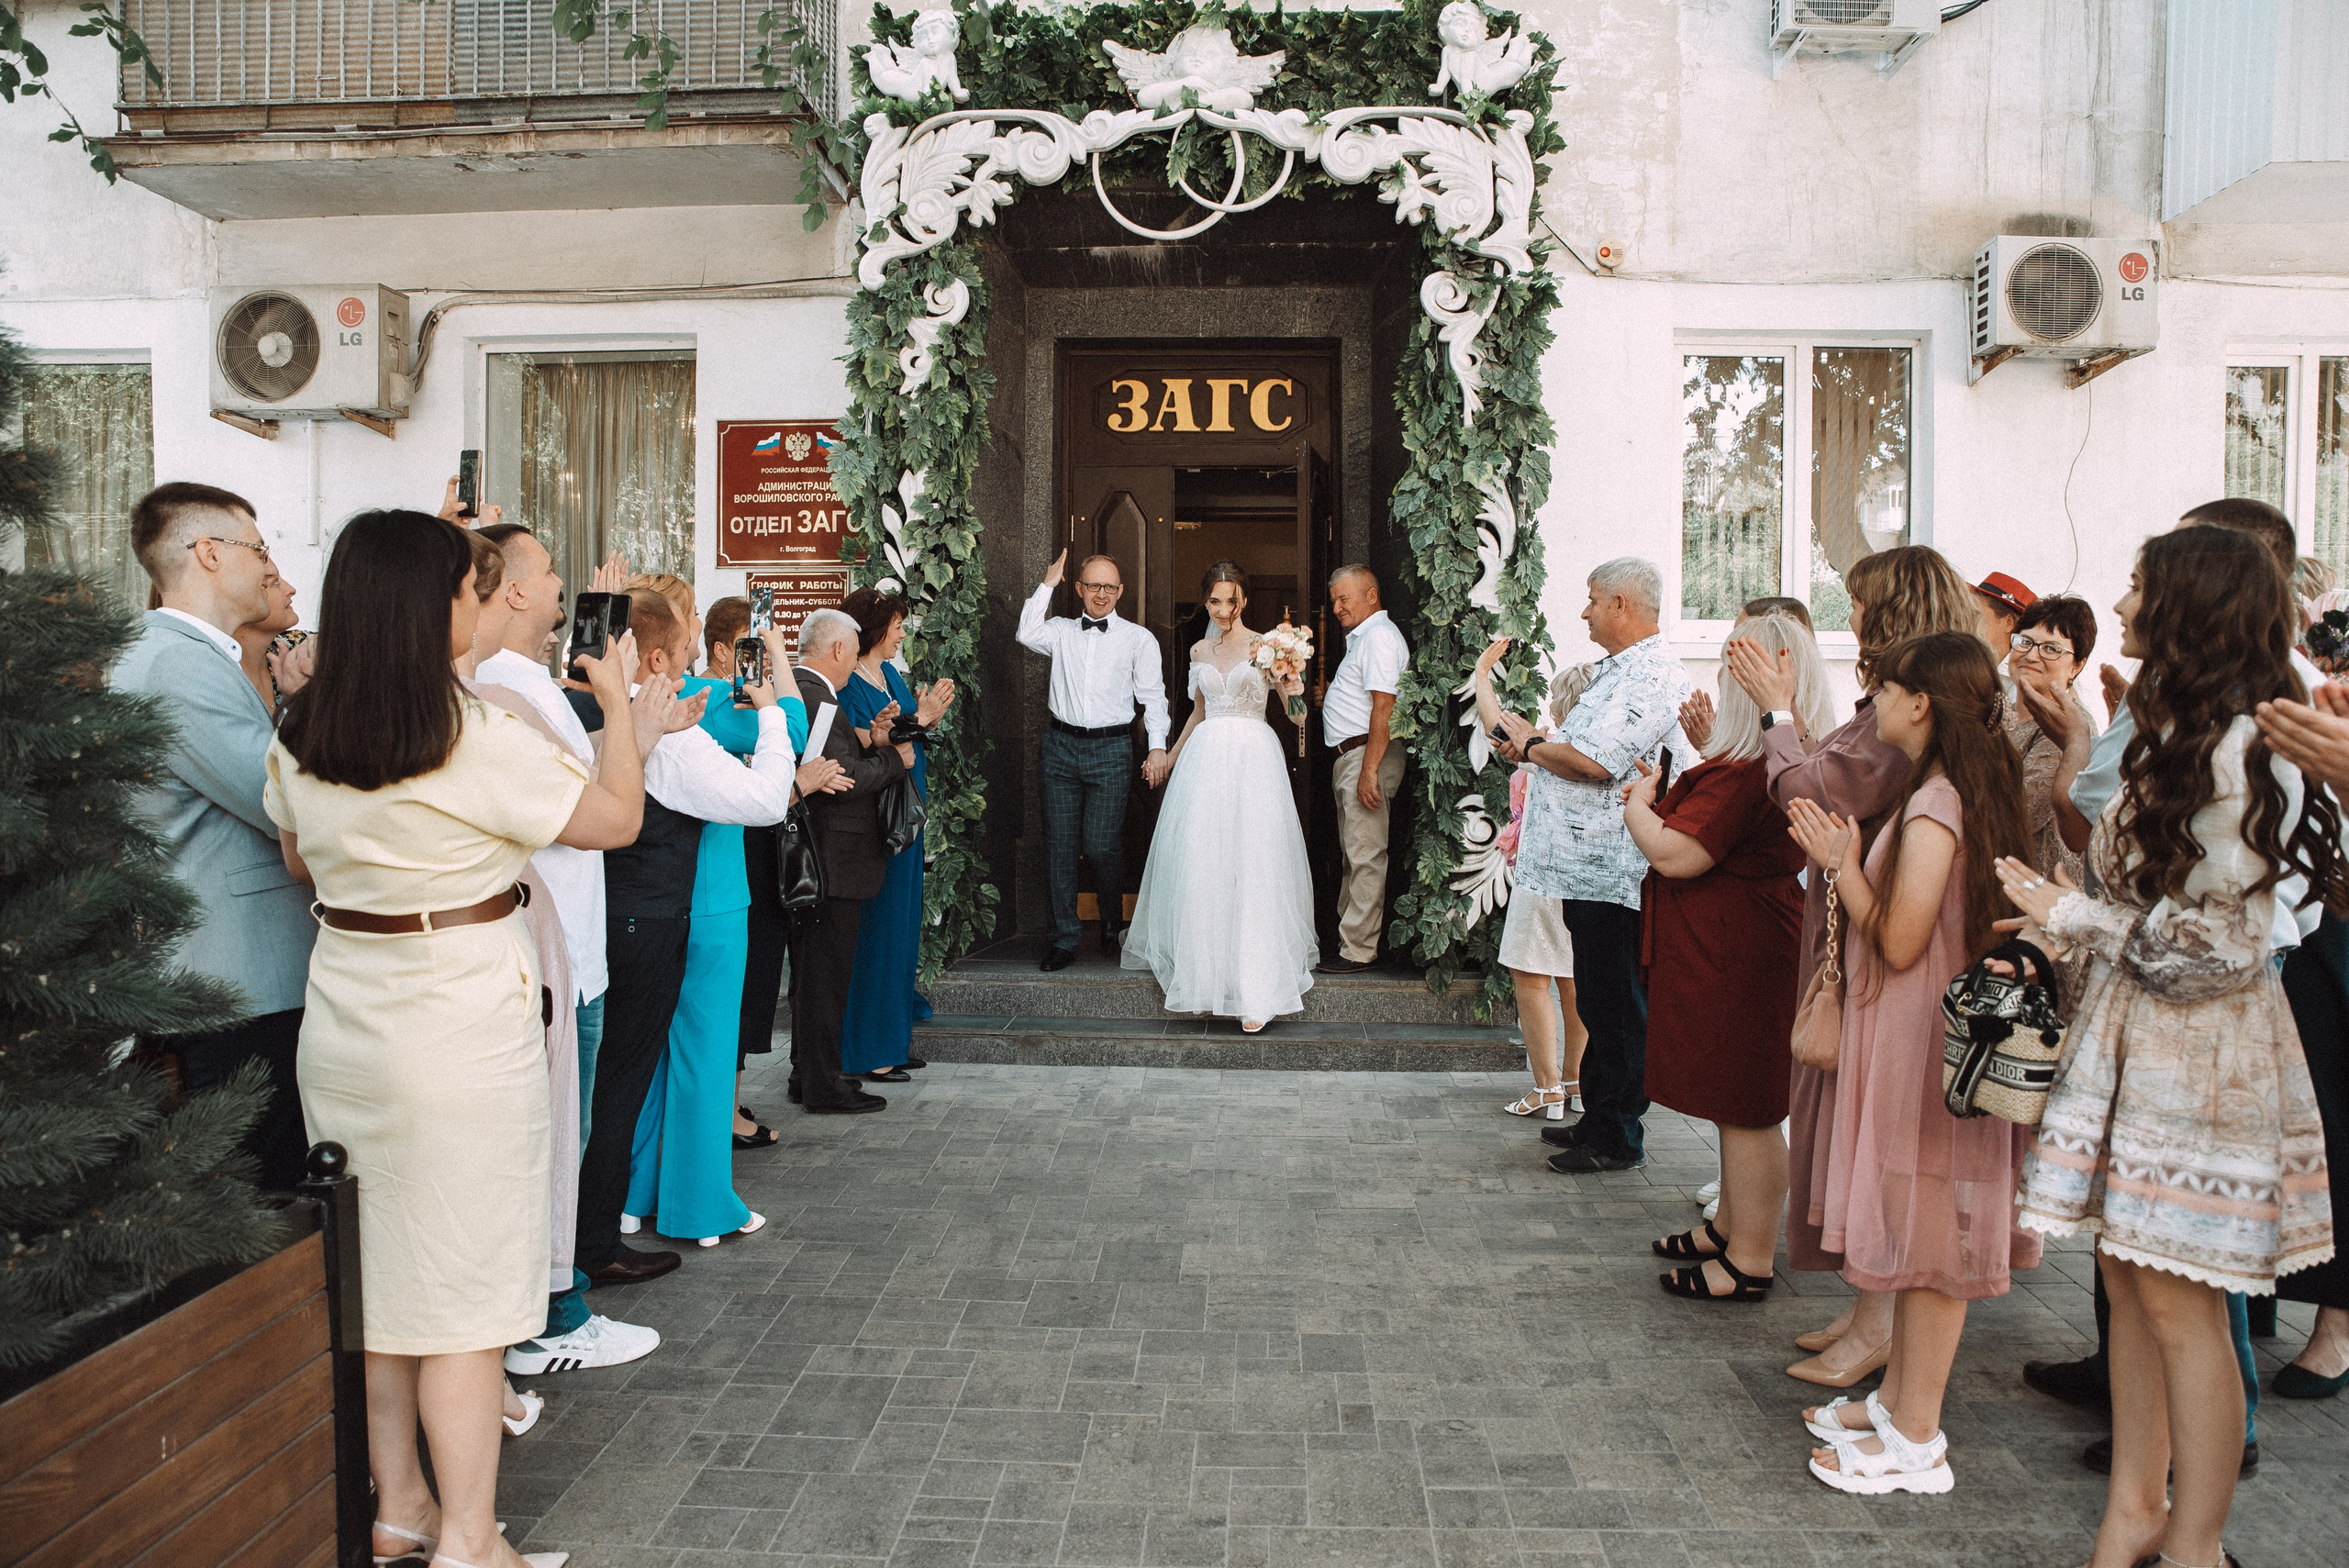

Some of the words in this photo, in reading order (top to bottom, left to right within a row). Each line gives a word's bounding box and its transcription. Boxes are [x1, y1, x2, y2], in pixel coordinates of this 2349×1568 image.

[2121, 286, 2144, 301] LG
[340, 331, 362, 347] LG
[1107, 378, 1293, 433] ЗАГС
[761, 466, 799, 474] РОССИЙСКАЯ
[800, 466, 828, 474] ФЕДЕРАЦ
[758, 481, 832, 493] АДМИНИСТРАЦИ
[733, 493, 823, 504] ВОРОШИЛОВСКОГО
[729, 516, 792, 537] ОТДЕЛ
[785, 545, 817, 553] Волгоград
[751, 581, 794, 590] ГРАФИК
[799, 581, 843, 590] РАБОТЫ
[802, 610, 812, 618] 17
[1996, 1062, 2026, 1082] DIOR
